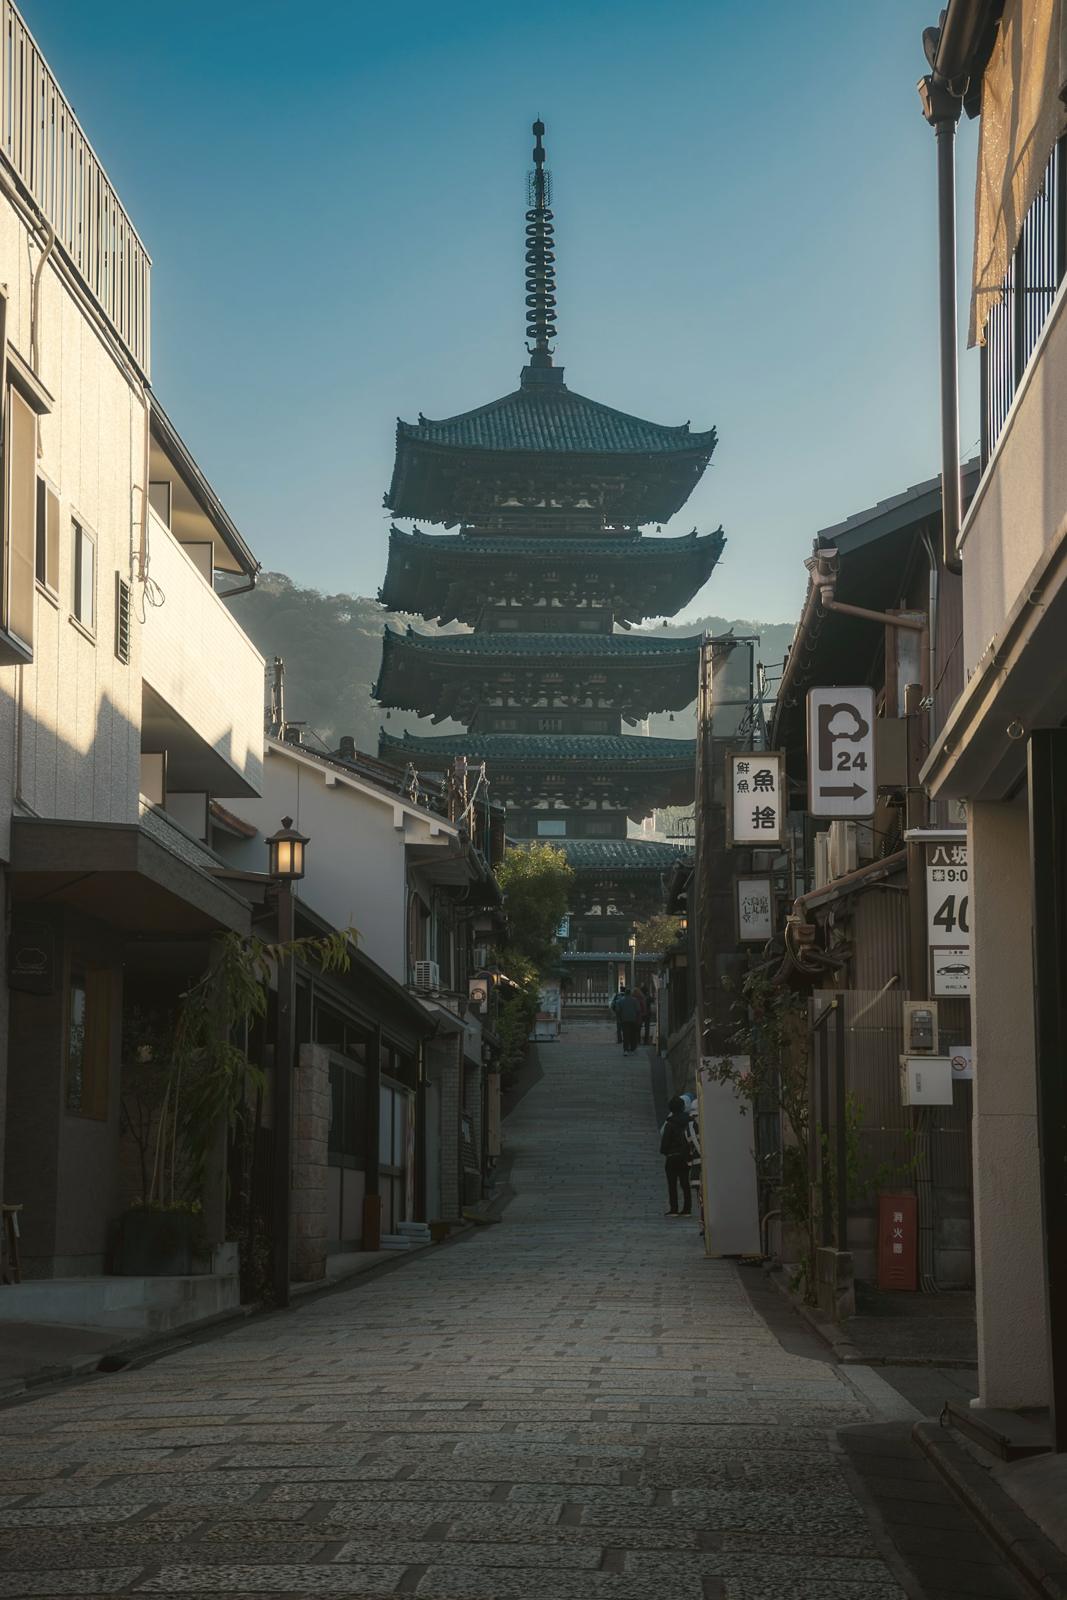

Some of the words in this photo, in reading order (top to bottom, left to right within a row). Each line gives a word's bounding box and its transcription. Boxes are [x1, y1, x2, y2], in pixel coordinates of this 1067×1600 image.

[736, 761, 750, 793] 鮮魚
[836, 751, 868, 771] 24
[752, 769, 776, 829] 魚捨
